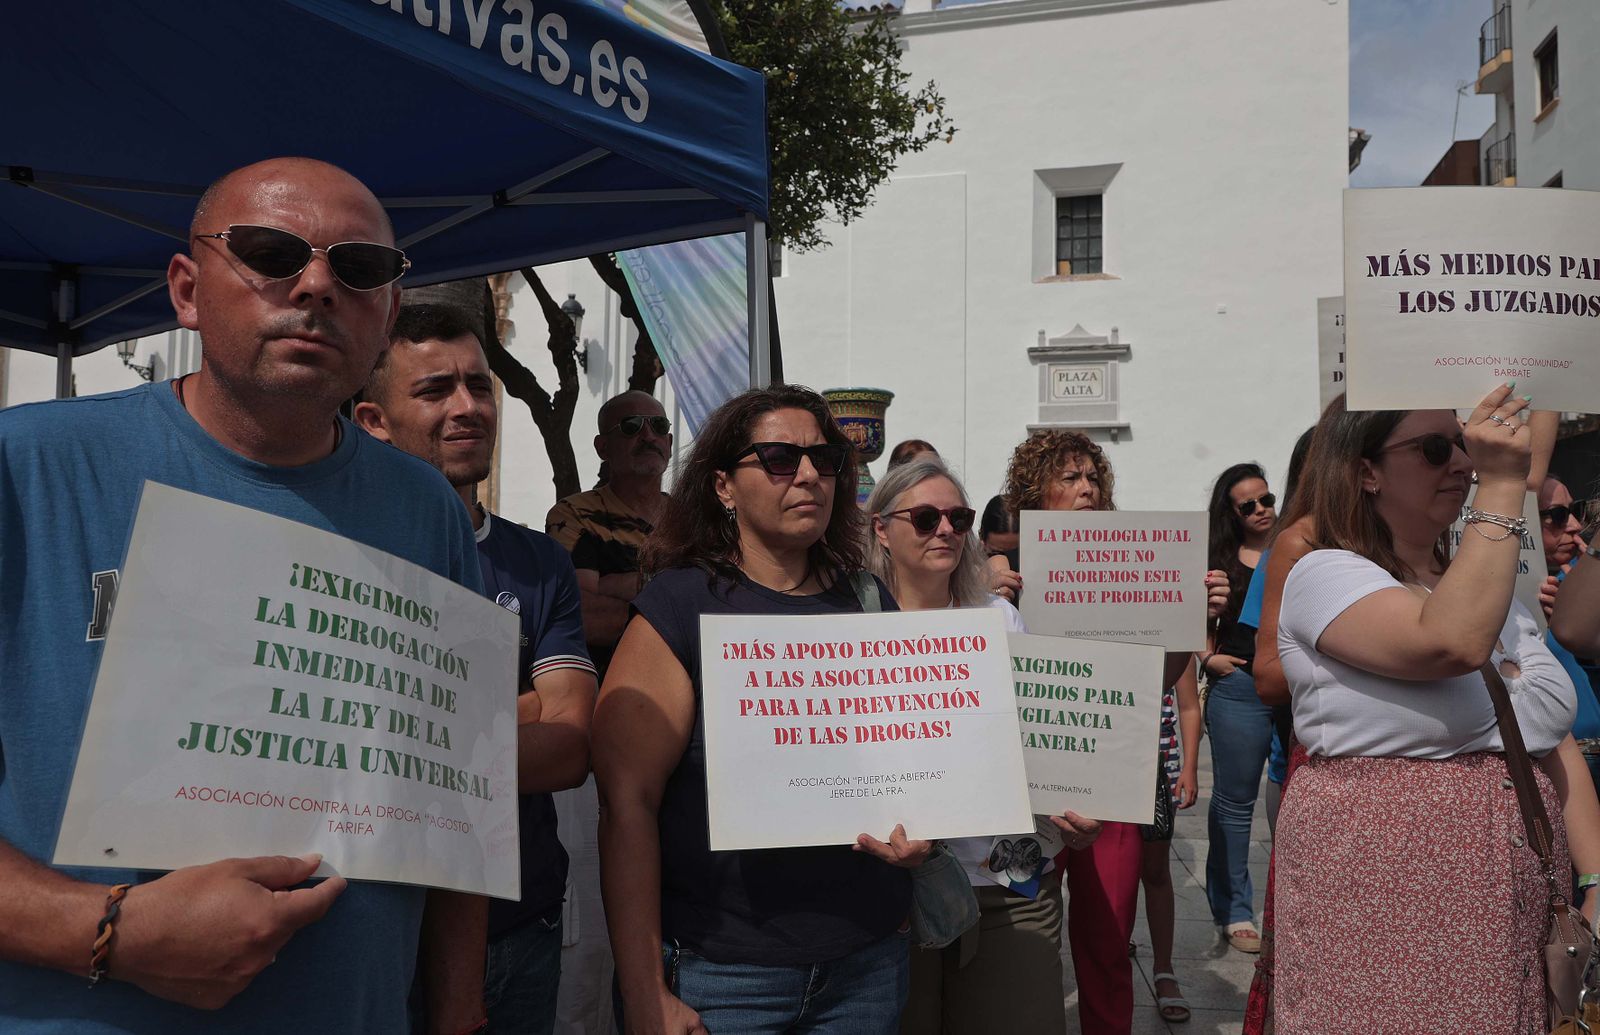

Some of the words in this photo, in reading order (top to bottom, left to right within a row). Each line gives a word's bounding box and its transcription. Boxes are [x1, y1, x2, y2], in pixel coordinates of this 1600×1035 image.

[371, 0, 649, 123] vas.es
[1366, 249, 1431, 278] MÁS
[1440, 253, 1551, 277] MEDIOS
[1399, 290, 1456, 314] LOS
[1464, 290, 1600, 318] JUZGADOS
[1434, 355, 1501, 367] ASOCIACIÓN
[1503, 356, 1519, 367] "LA
[1520, 357, 1574, 369] COMUNIDAD"
[1494, 368, 1531, 378] BARBATE
[1058, 371, 1098, 382] PLAZA
[1062, 385, 1093, 395] ALTA
[1038, 529, 1057, 542] LA
[1061, 529, 1148, 542] PATOLOGIA
[1152, 529, 1191, 542] DUAL
[1076, 550, 1130, 563] EXISTE
[1134, 550, 1155, 563] NO
[1048, 570, 1140, 583] IGNOREMOS
[1143, 570, 1181, 583] ESTE
[289, 562, 440, 632] ¡EXIGIMOS!
[1044, 590, 1097, 604] GRAVE
[1101, 590, 1183, 603] PROBLEMA
[254, 596, 297, 629] LA
[306, 608, 470, 682] DEROGACIÓN
[1102, 629, 1137, 637] PROVINCIAL
[722, 639, 775, 660] ¡MÁS
[782, 641, 854, 660] APOYO
[860, 634, 987, 658] ECONÓMICO
[252, 639, 425, 703] INMEDIATA
[431, 683, 457, 714] DE
[744, 670, 759, 688] A
[765, 670, 804, 688] LAS
[810, 663, 970, 687] ASOCIACIONES
[1010, 655, 1093, 678] XIGIMOS
[739, 698, 800, 716] PARA
[805, 698, 832, 716] LA
[838, 687, 981, 716] PREVENCIÓN
[1084, 688, 1136, 707] PARA
[268, 687, 311, 720] LA
[319, 696, 381, 729] LEY
[387, 708, 420, 741] DE
[425, 720, 452, 751] LA
[1018, 706, 1113, 730] GILANCIA
[773, 727, 803, 745] DE
[809, 726, 848, 745] LAS
[854, 720, 952, 744] DROGAS!
[1021, 732, 1097, 753] ANERA!
[177, 721, 349, 770] JUSTICIA
[359, 745, 494, 802] UNIVERSAL
[788, 775, 850, 787] ASOCIACIÓN
[852, 773, 897, 785] "PUERTAS
[899, 770, 946, 782] ABIERTAS"
[1040, 784, 1092, 795] ALTERNATIVAS
[830, 788, 855, 799] JEREZ
[856, 788, 869, 798] DE
[871, 787, 884, 797] LA
[885, 786, 907, 797] FRA.
[174, 786, 285, 808] ASOCIACIÓN
[288, 796, 350, 816] CONTRA
[353, 804, 372, 818] LA
[376, 805, 422, 824] DROGA
[424, 814, 474, 834] "AGOSTO"
[327, 819, 375, 836] TARIFA
